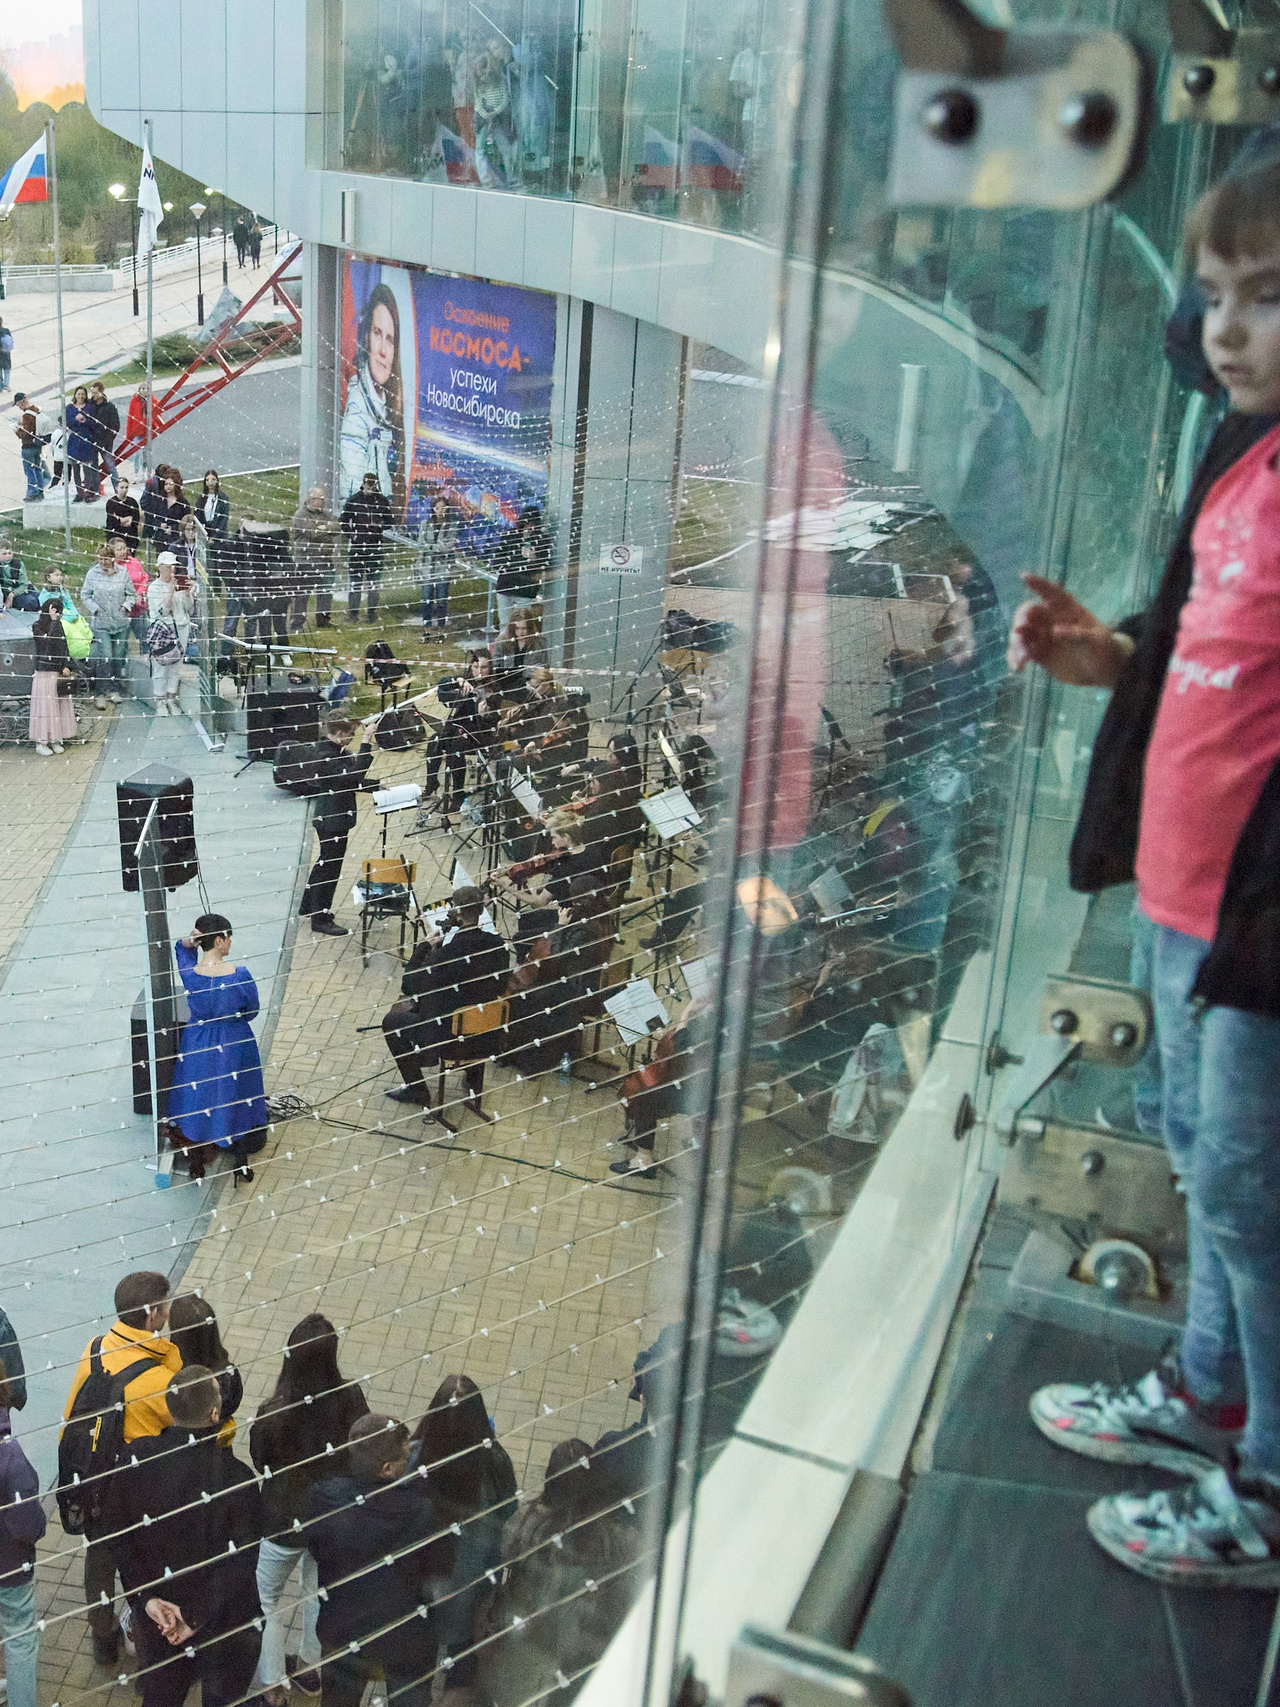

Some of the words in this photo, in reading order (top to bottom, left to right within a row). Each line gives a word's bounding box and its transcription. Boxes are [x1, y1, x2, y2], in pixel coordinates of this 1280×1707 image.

[443, 300, 510, 333] Освоение
[450, 368, 497, 395] успехи
[427, 382, 521, 430] Новосибирска
